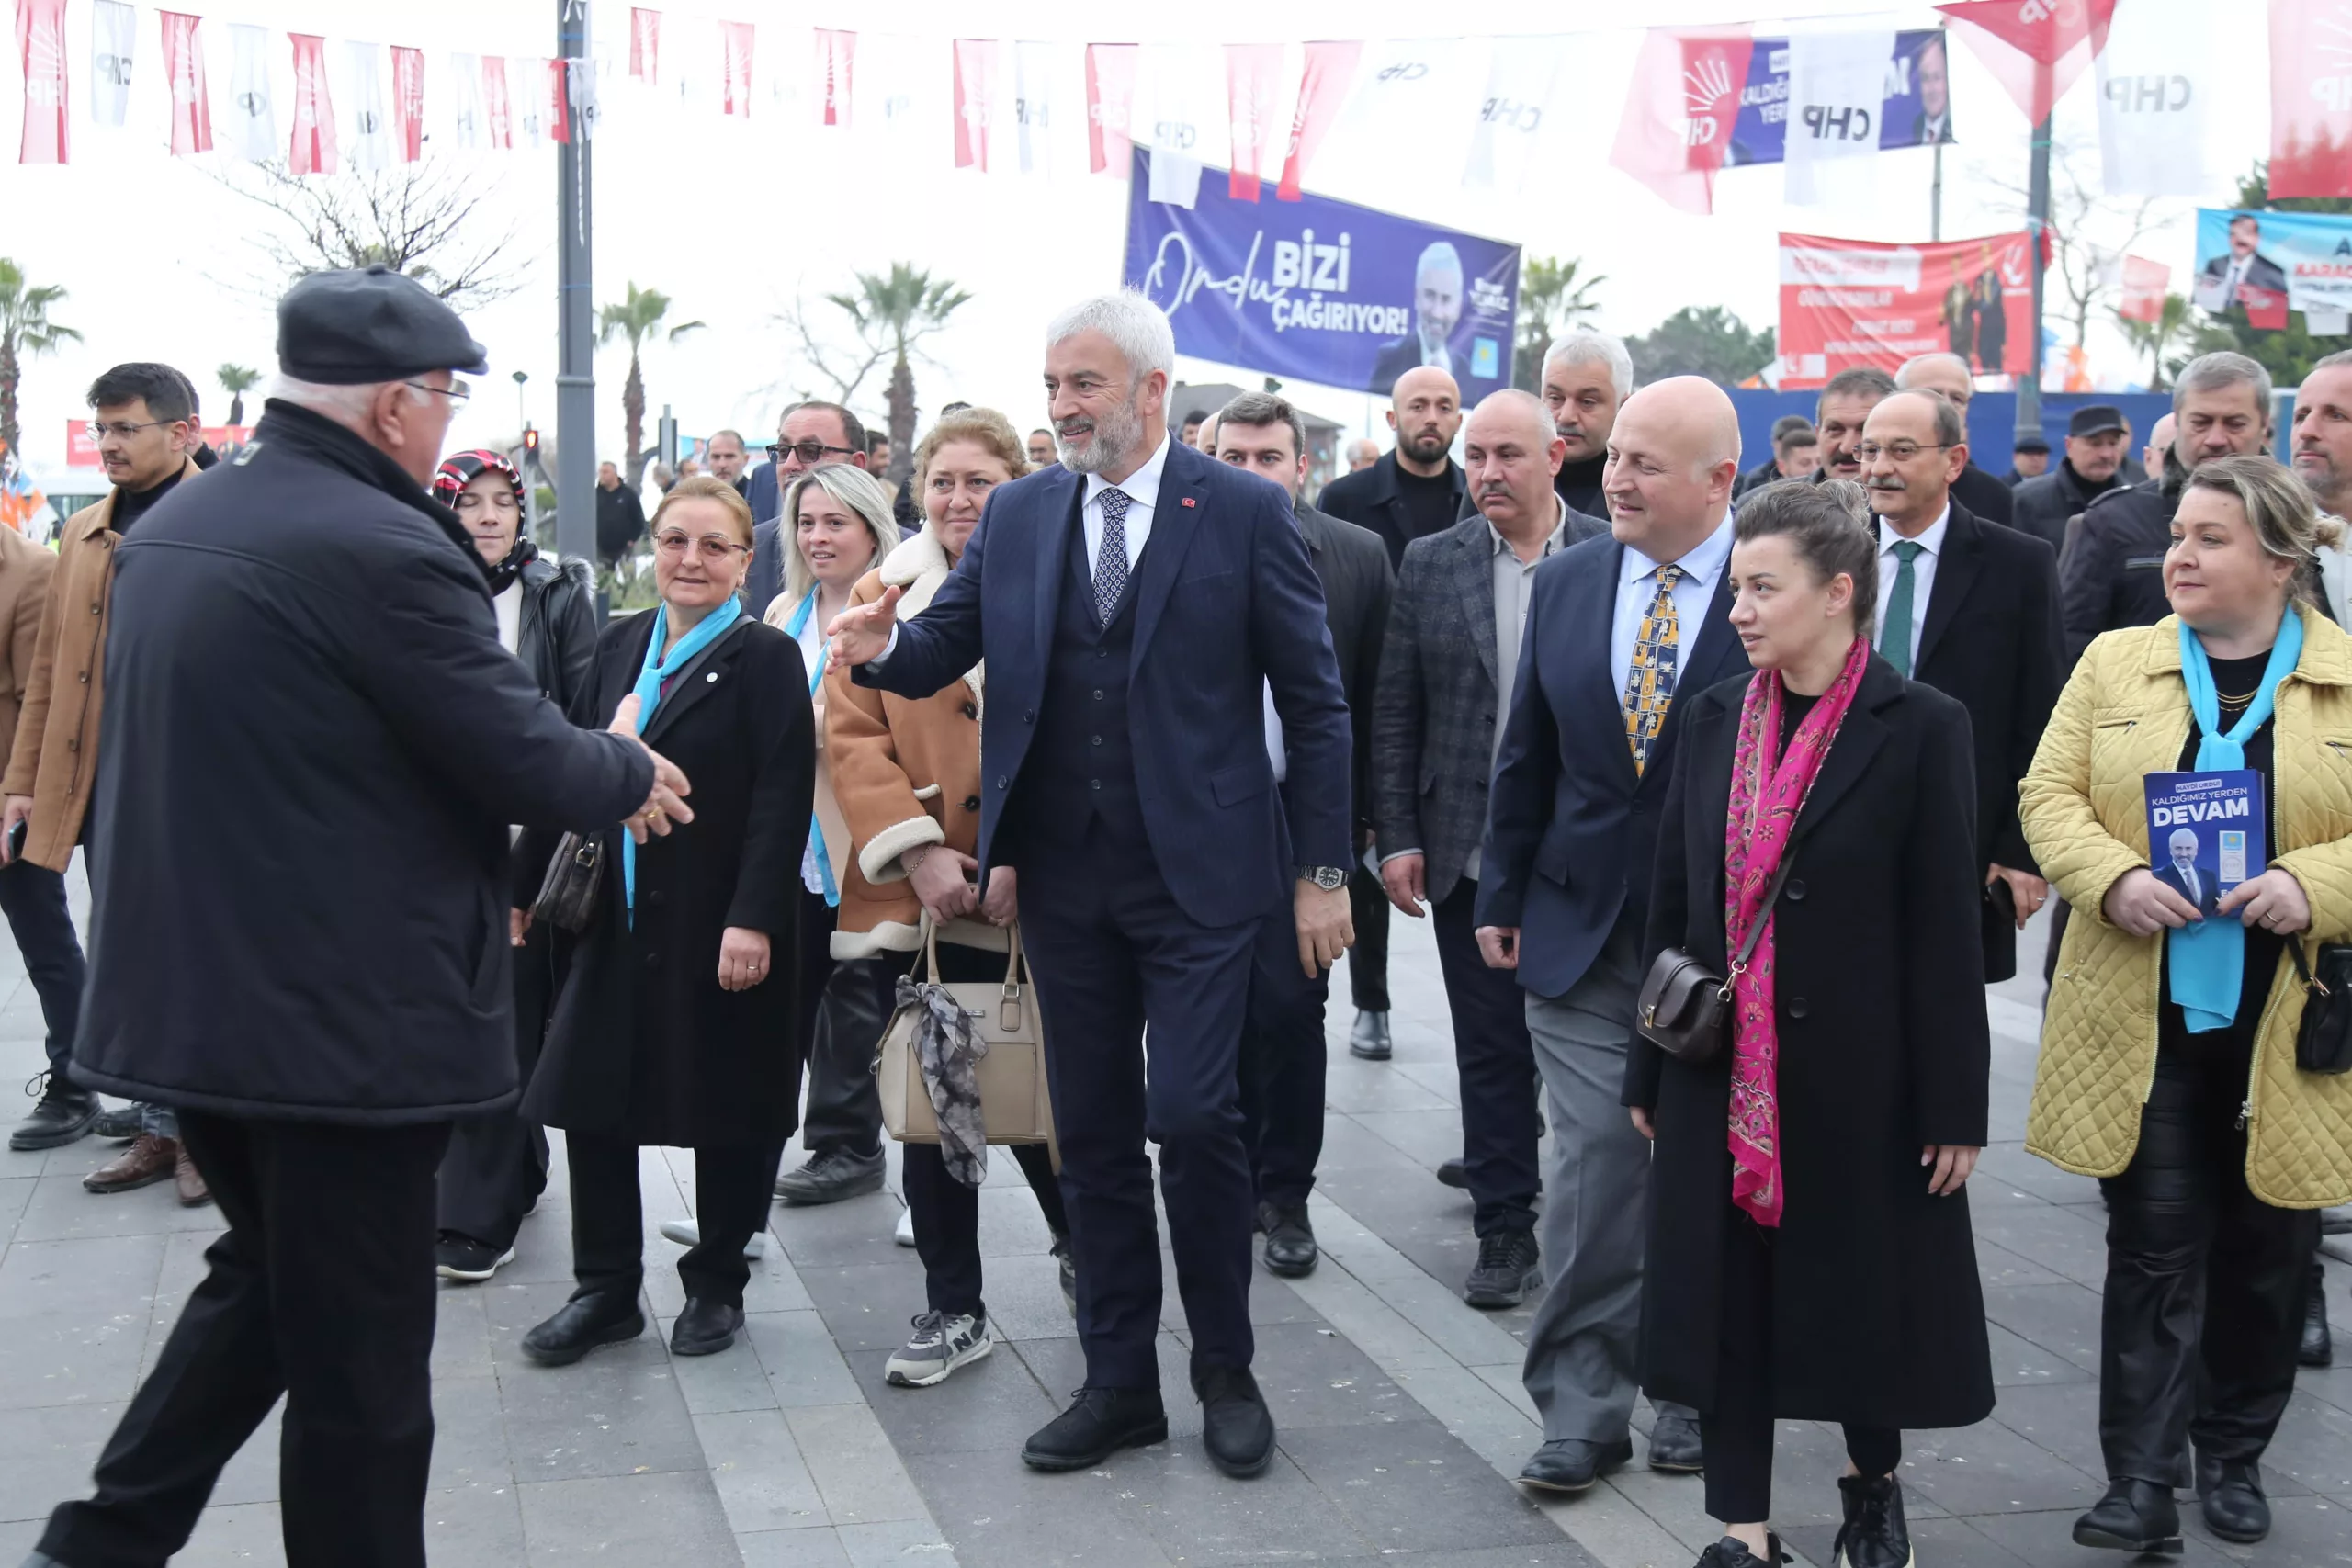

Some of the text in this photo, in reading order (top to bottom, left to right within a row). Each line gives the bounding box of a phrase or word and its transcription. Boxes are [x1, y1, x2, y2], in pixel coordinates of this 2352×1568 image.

[1144, 228, 1351, 318] Ordu BİZİ
[1272, 291, 1409, 336] ÇAĞIRIYOR!
[2152, 787, 2248, 806] KALDIĞIMIZ YERDEN
[2153, 797, 2249, 827] DEVAM
